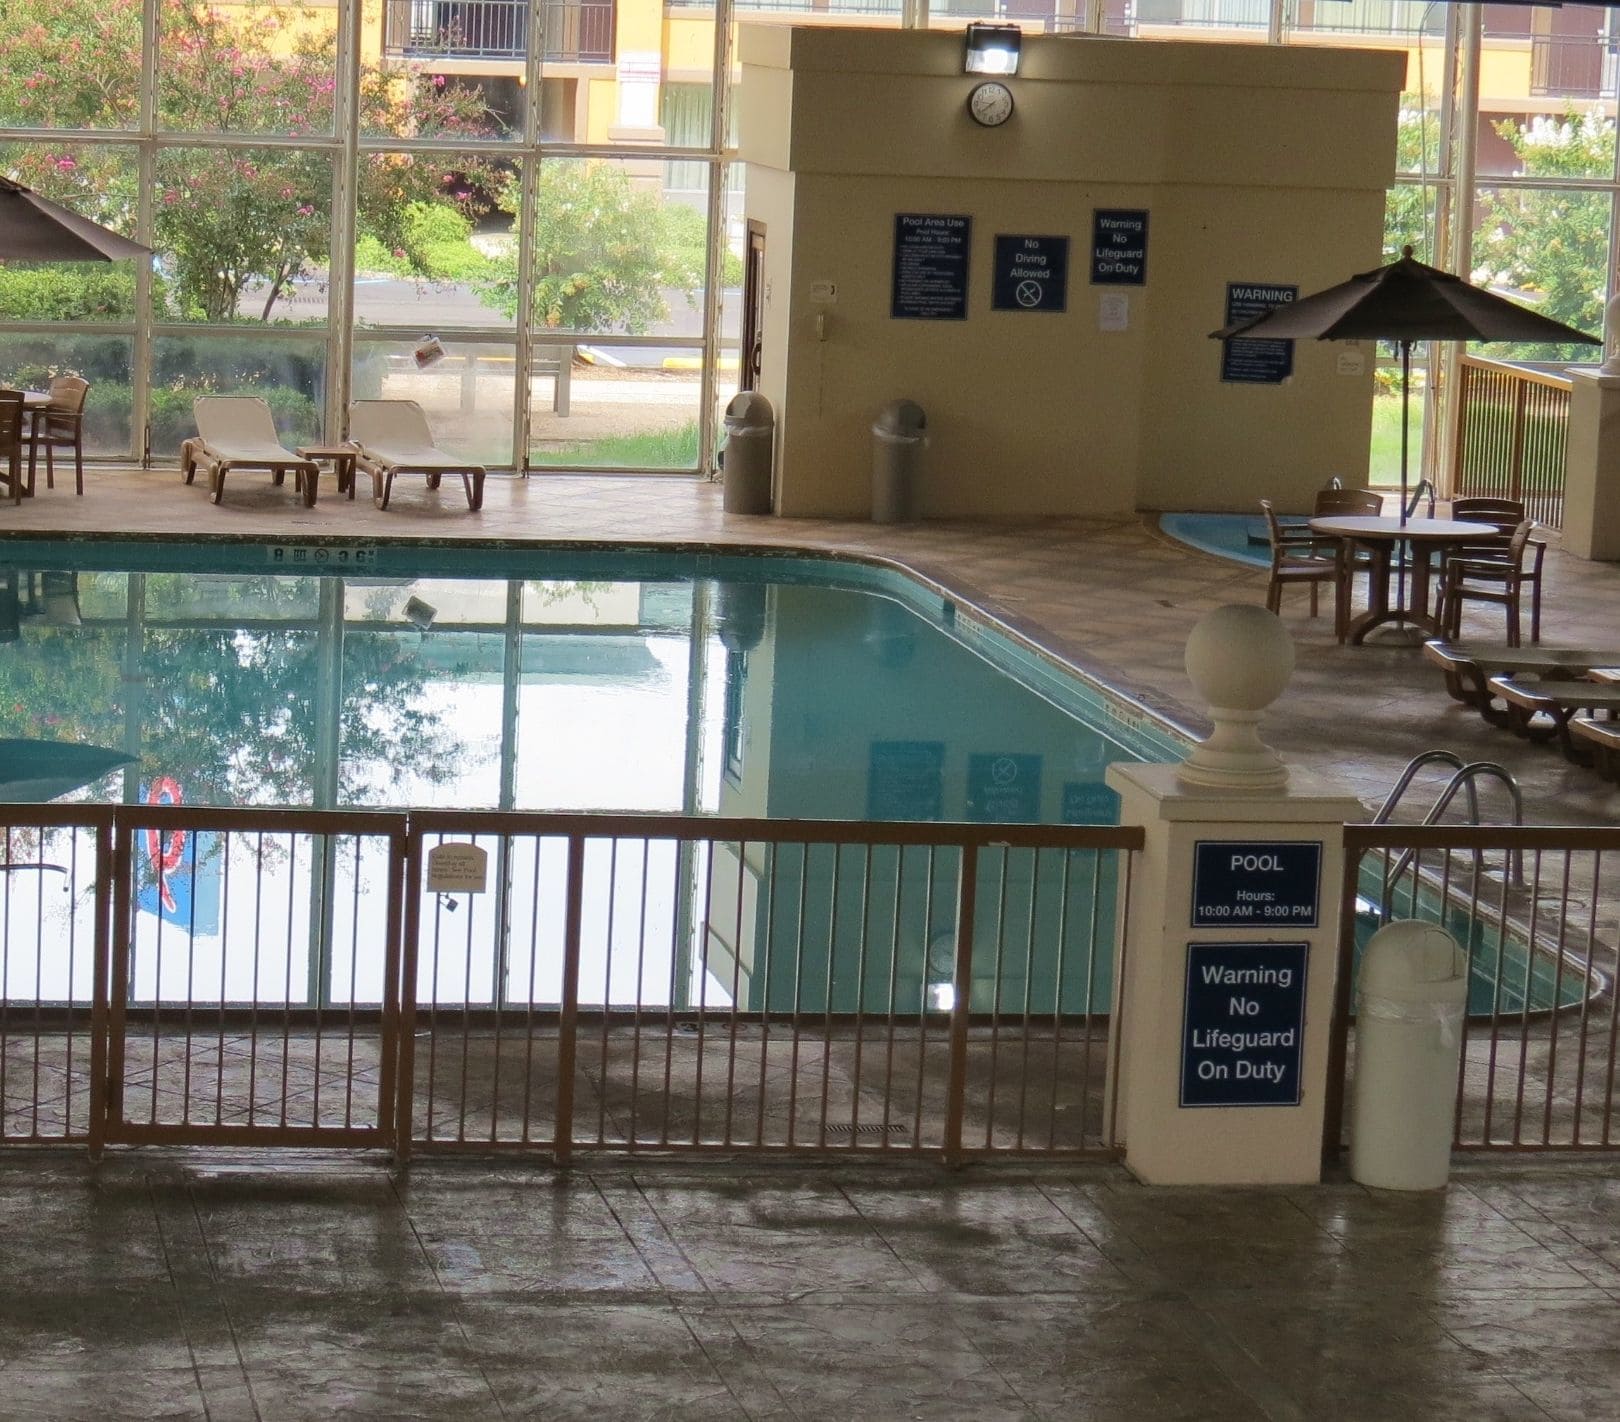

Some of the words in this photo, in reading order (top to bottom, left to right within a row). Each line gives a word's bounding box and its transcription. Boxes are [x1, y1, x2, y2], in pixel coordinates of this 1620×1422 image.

[902, 216, 922, 226] Pool
[924, 218, 945, 226] Area
[947, 218, 964, 228] Use
[1100, 218, 1142, 231] Warning
[1024, 239, 1039, 249] No
[1112, 234, 1128, 244] No
[1015, 253, 1047, 266] Diving
[1096, 248, 1143, 260] Lifeguard
[1010, 268, 1050, 279] Allowed
[1098, 262, 1113, 272] On
[1115, 263, 1139, 275] Duty
[1232, 288, 1293, 302] WARNING
[1231, 855, 1284, 872] POOL
[1236, 890, 1276, 901] Hours:
[1198, 905, 1230, 917] 10:00
[1232, 906, 1253, 917] AM
[1264, 906, 1289, 917] 9:00
[1292, 906, 1312, 917] PM
[1202, 966, 1292, 988] Warning
[1230, 997, 1260, 1016] No
[1193, 1028, 1294, 1052] Lifeguard
[1198, 1060, 1228, 1080] On
[1236, 1060, 1286, 1084] Duty
